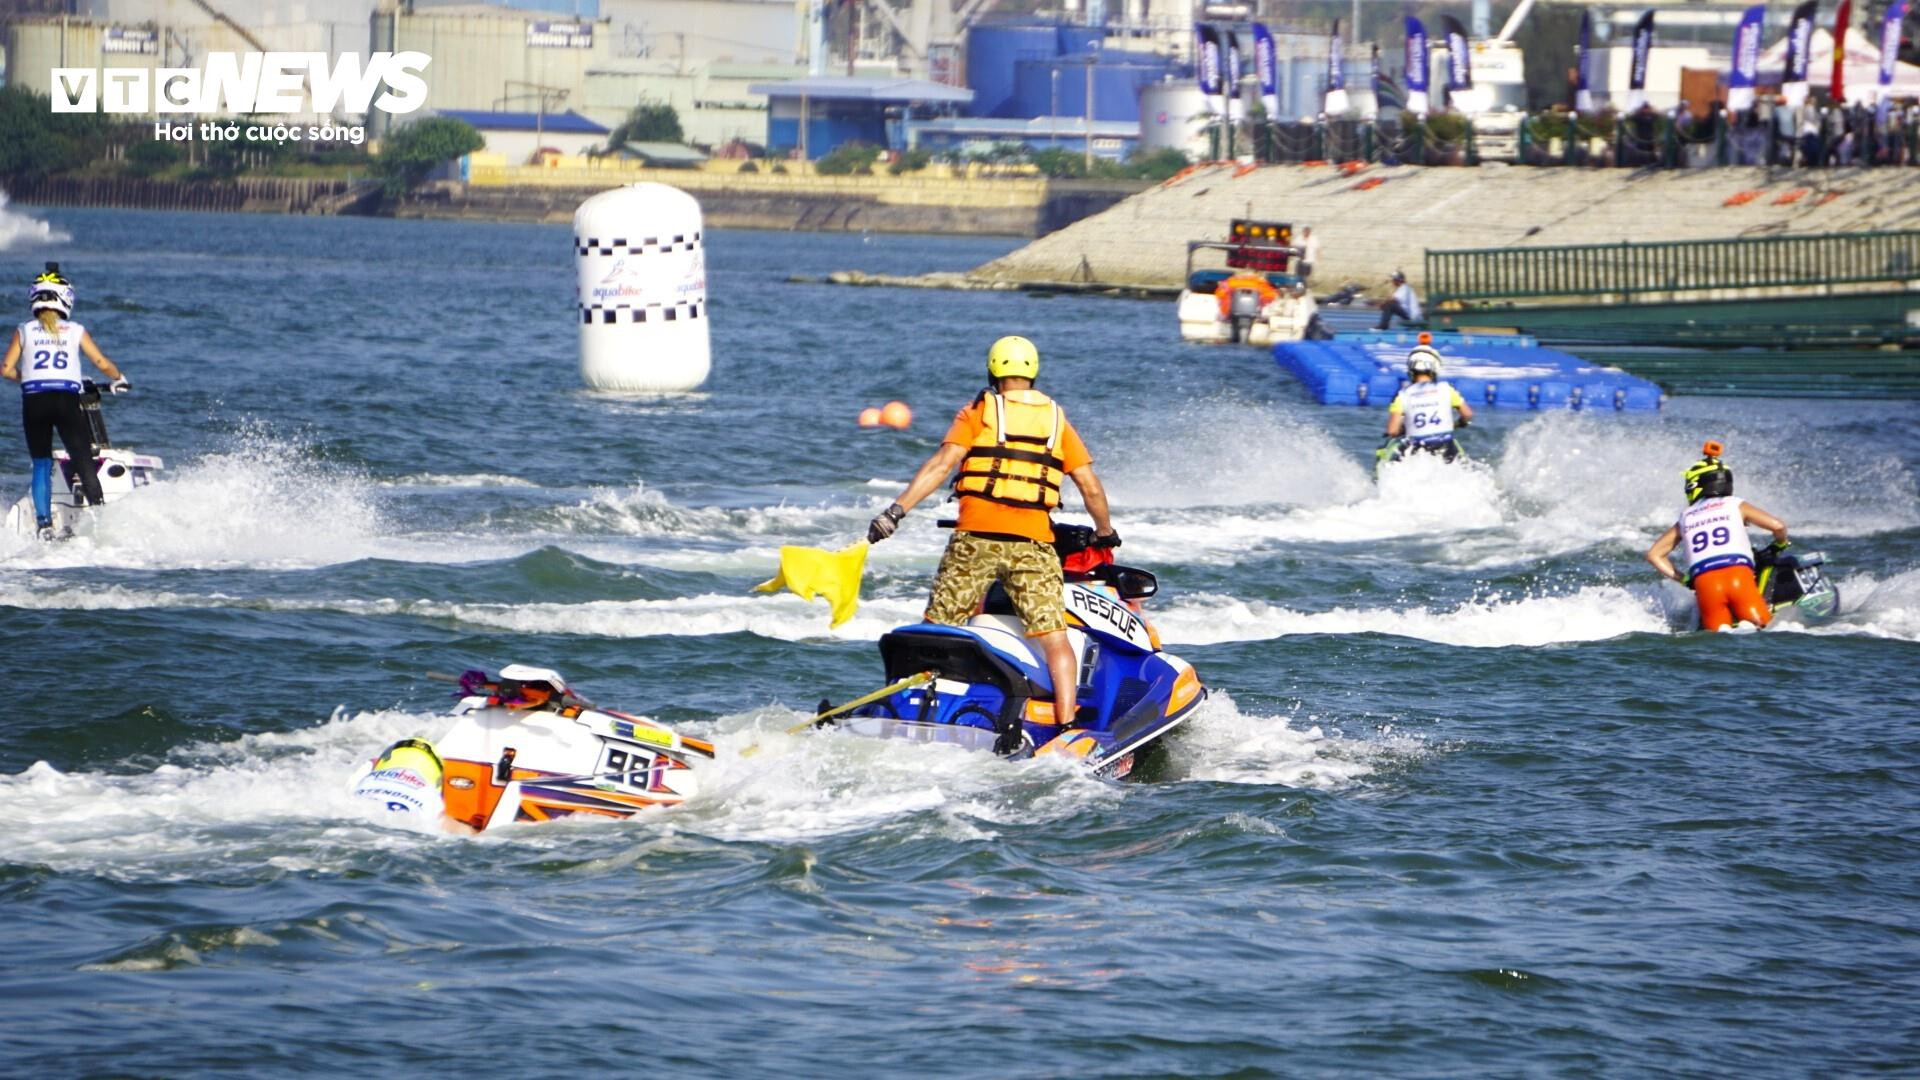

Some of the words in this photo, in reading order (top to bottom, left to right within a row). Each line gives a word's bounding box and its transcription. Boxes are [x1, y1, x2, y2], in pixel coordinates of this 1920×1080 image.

[593, 284, 642, 300] aquabike
[33, 350, 69, 371] 26
[1413, 411, 1442, 428] 64
[1692, 526, 1731, 553] 99
[1071, 589, 1137, 641] RESCUE
[606, 747, 651, 792] 98
